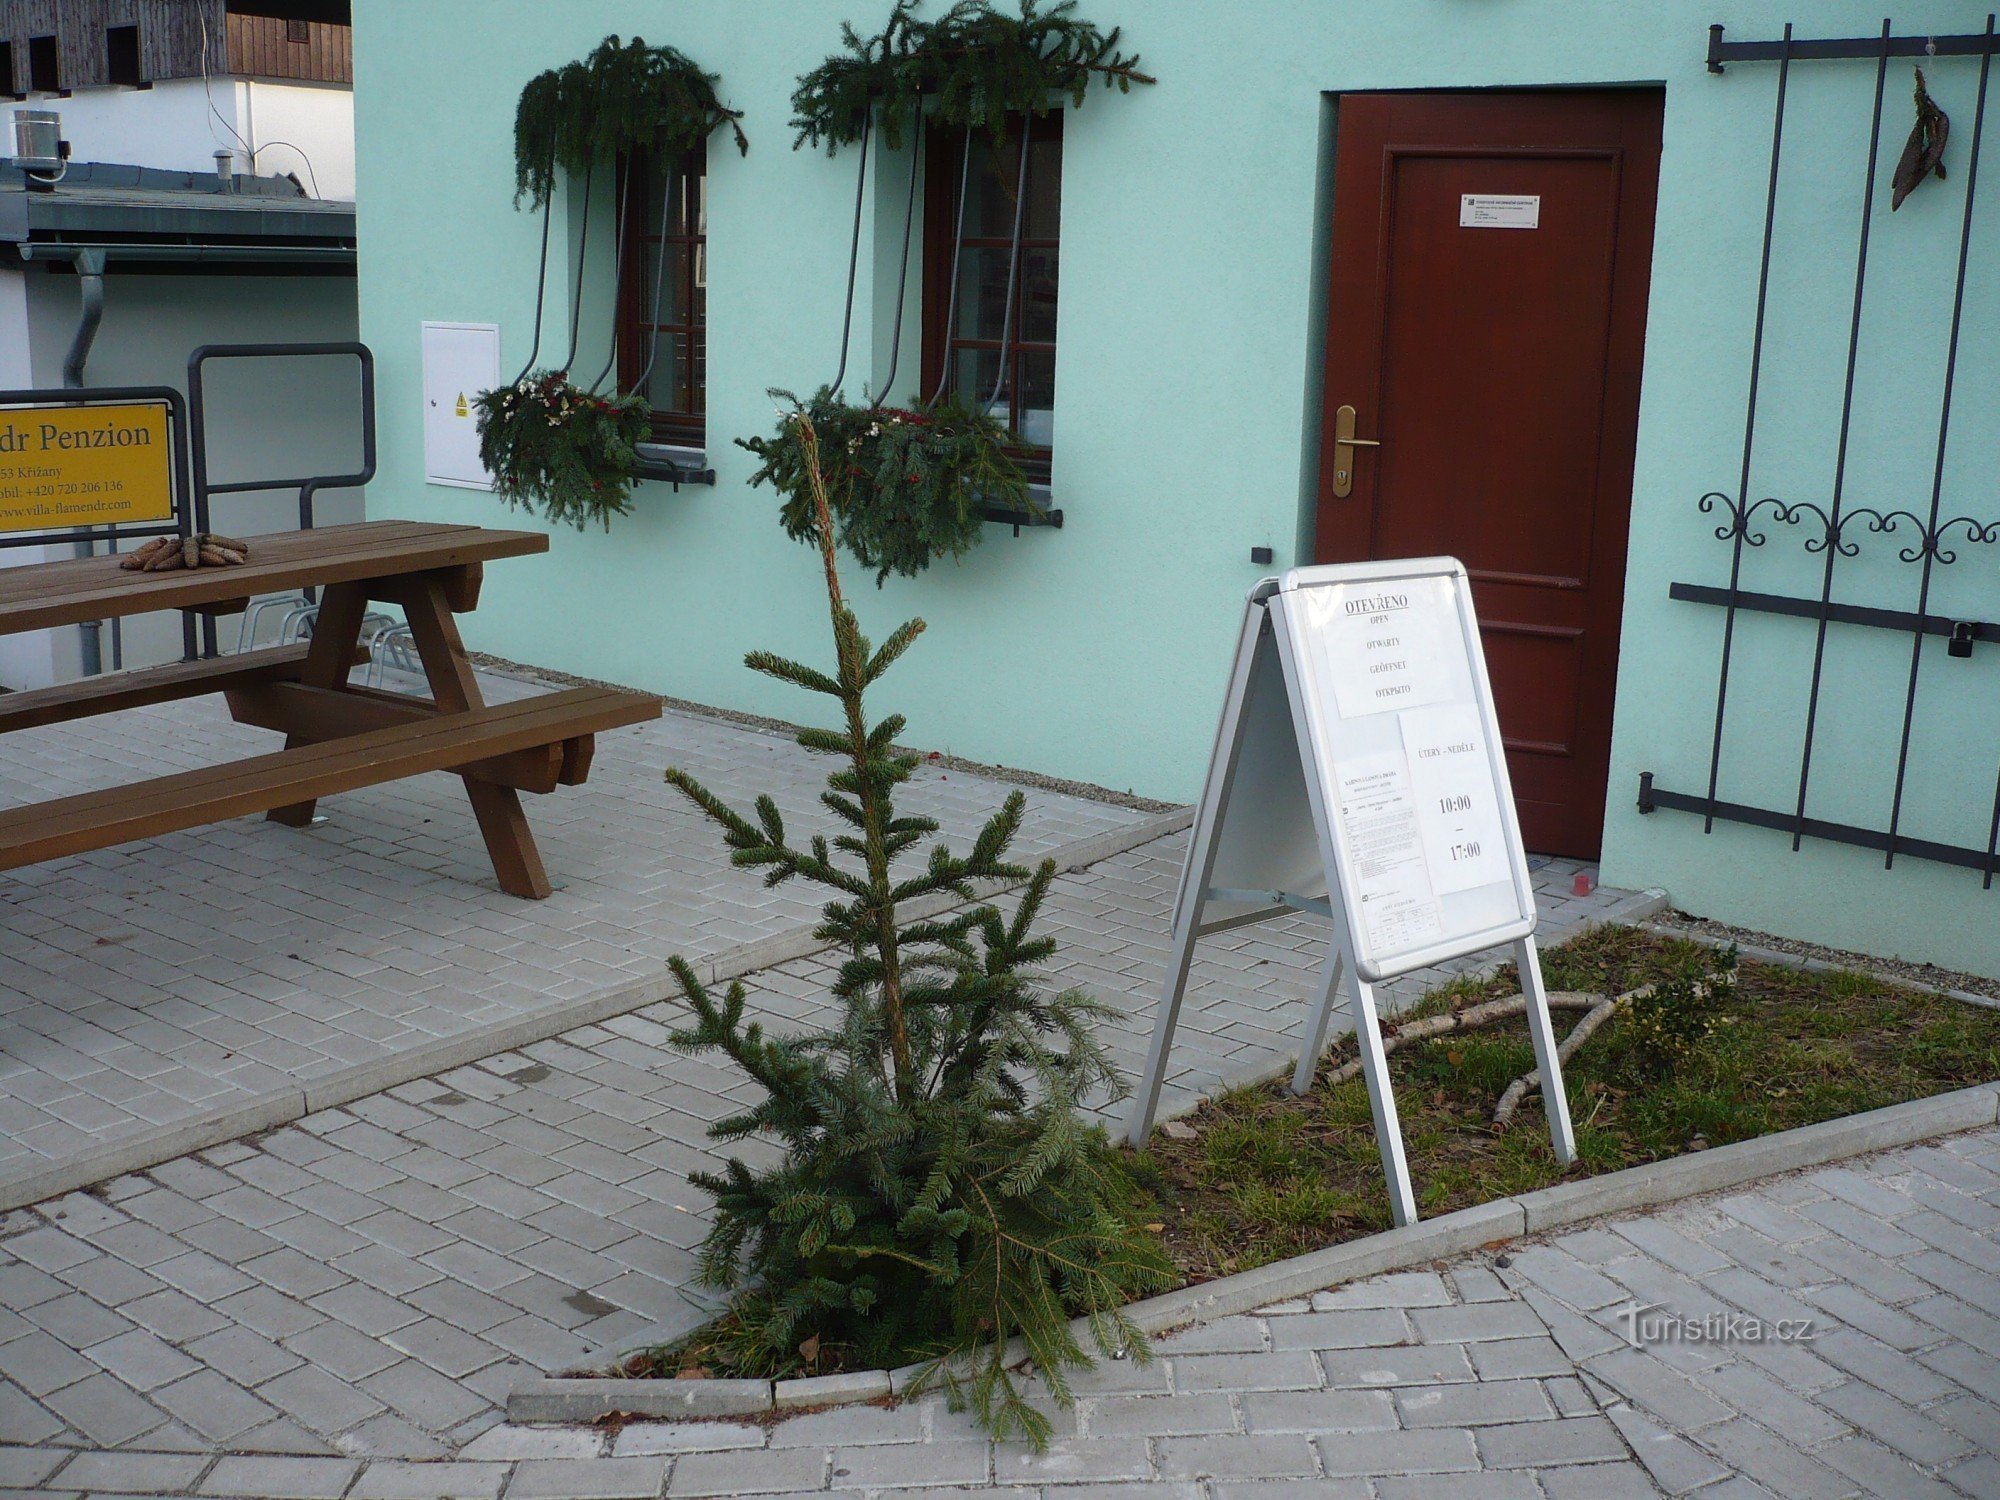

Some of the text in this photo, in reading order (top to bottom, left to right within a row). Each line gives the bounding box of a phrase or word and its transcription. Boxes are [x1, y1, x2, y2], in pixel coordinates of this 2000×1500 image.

[39, 422, 151, 451] Penzion
[26, 485, 54, 497] +420
[58, 483, 78, 495] 720
[81, 482, 100, 494] 206
[105, 481, 123, 492] 136
[1345, 594, 1408, 615] OTEVŘENO
[1370, 614, 1389, 625] OPEN
[1366, 637, 1401, 650] OTWARTY
[1369, 661, 1407, 674] GEÖFFNET
[1447, 742, 1476, 754] NEDĚLE
[1439, 794, 1471, 814] 10:00
[1450, 841, 1481, 861] 17:00
